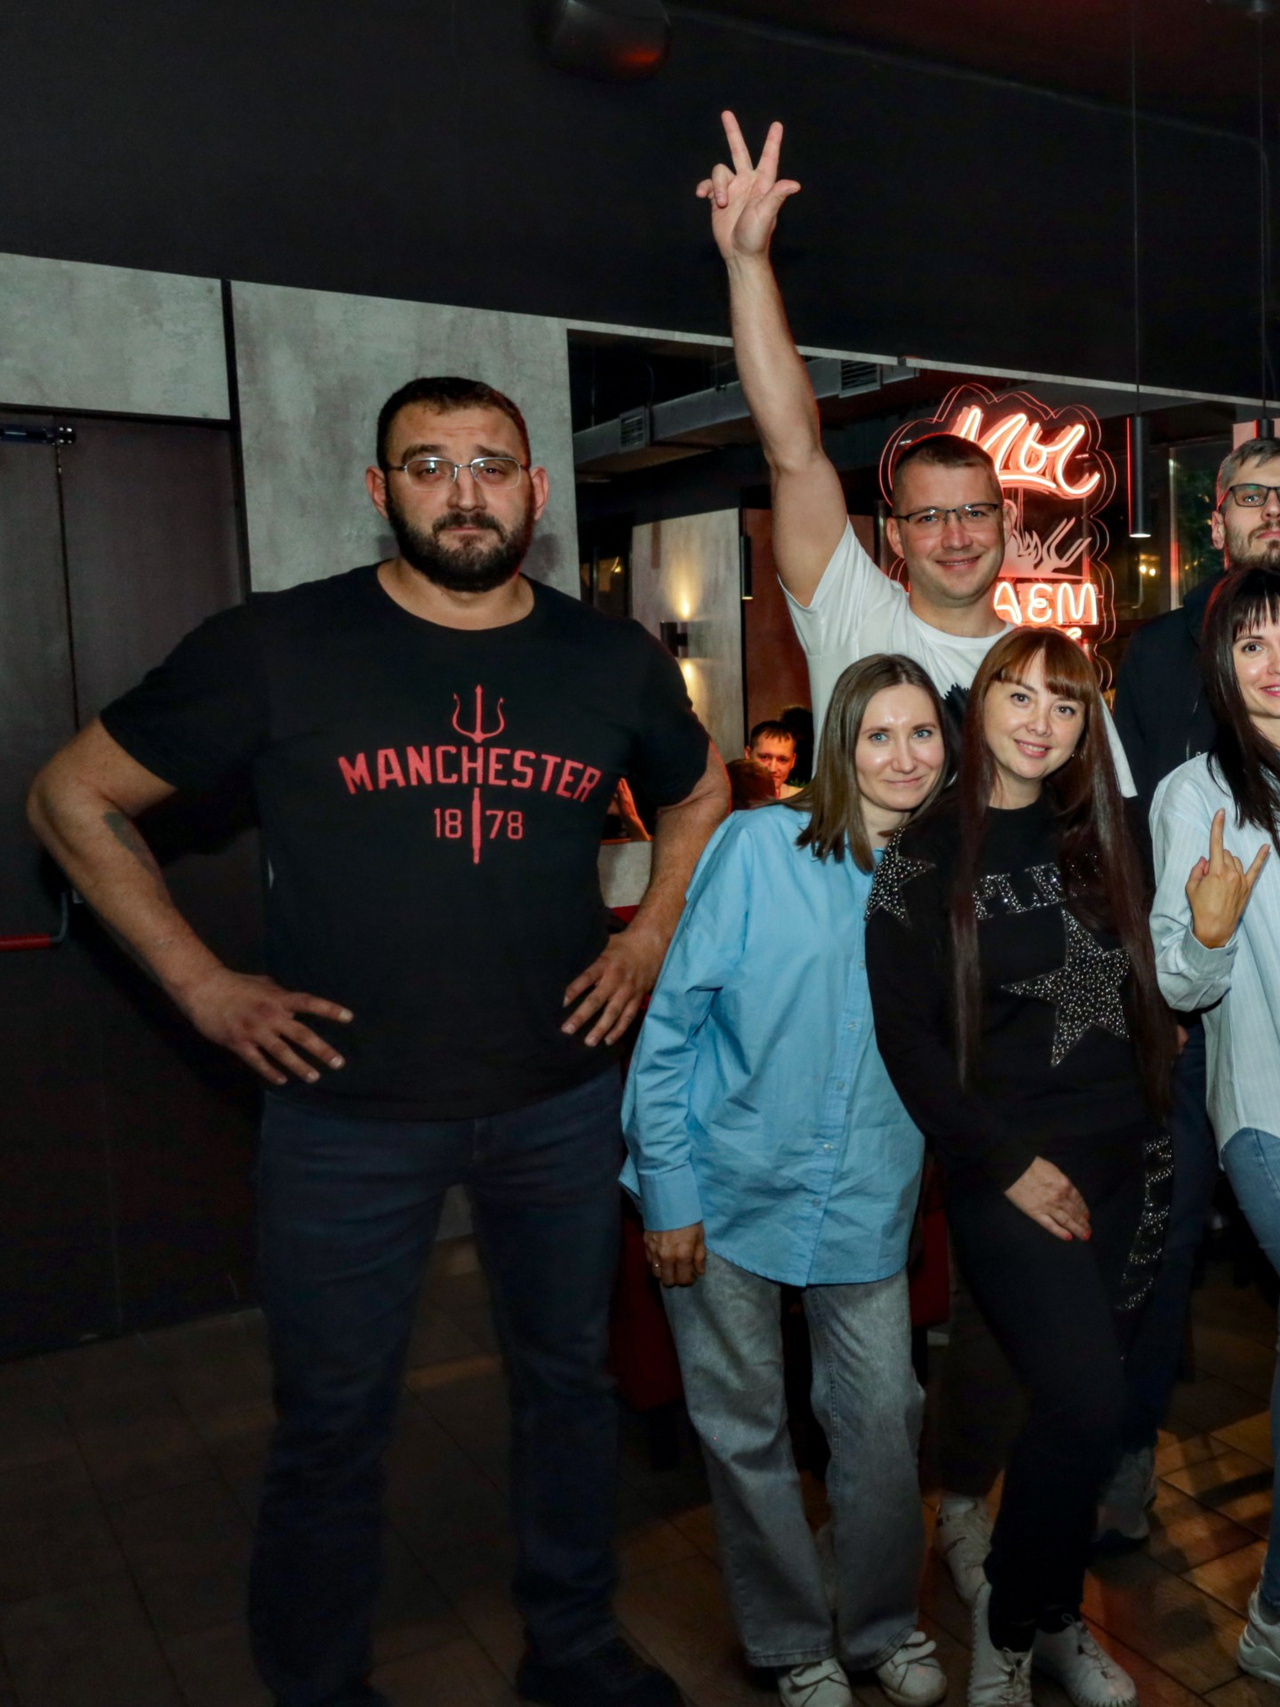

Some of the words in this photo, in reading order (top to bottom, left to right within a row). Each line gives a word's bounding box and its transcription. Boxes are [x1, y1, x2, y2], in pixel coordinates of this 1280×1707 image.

[338, 745, 602, 802] MANCHESTER
[434, 808, 463, 839] 18
[485, 810, 524, 840] 78
